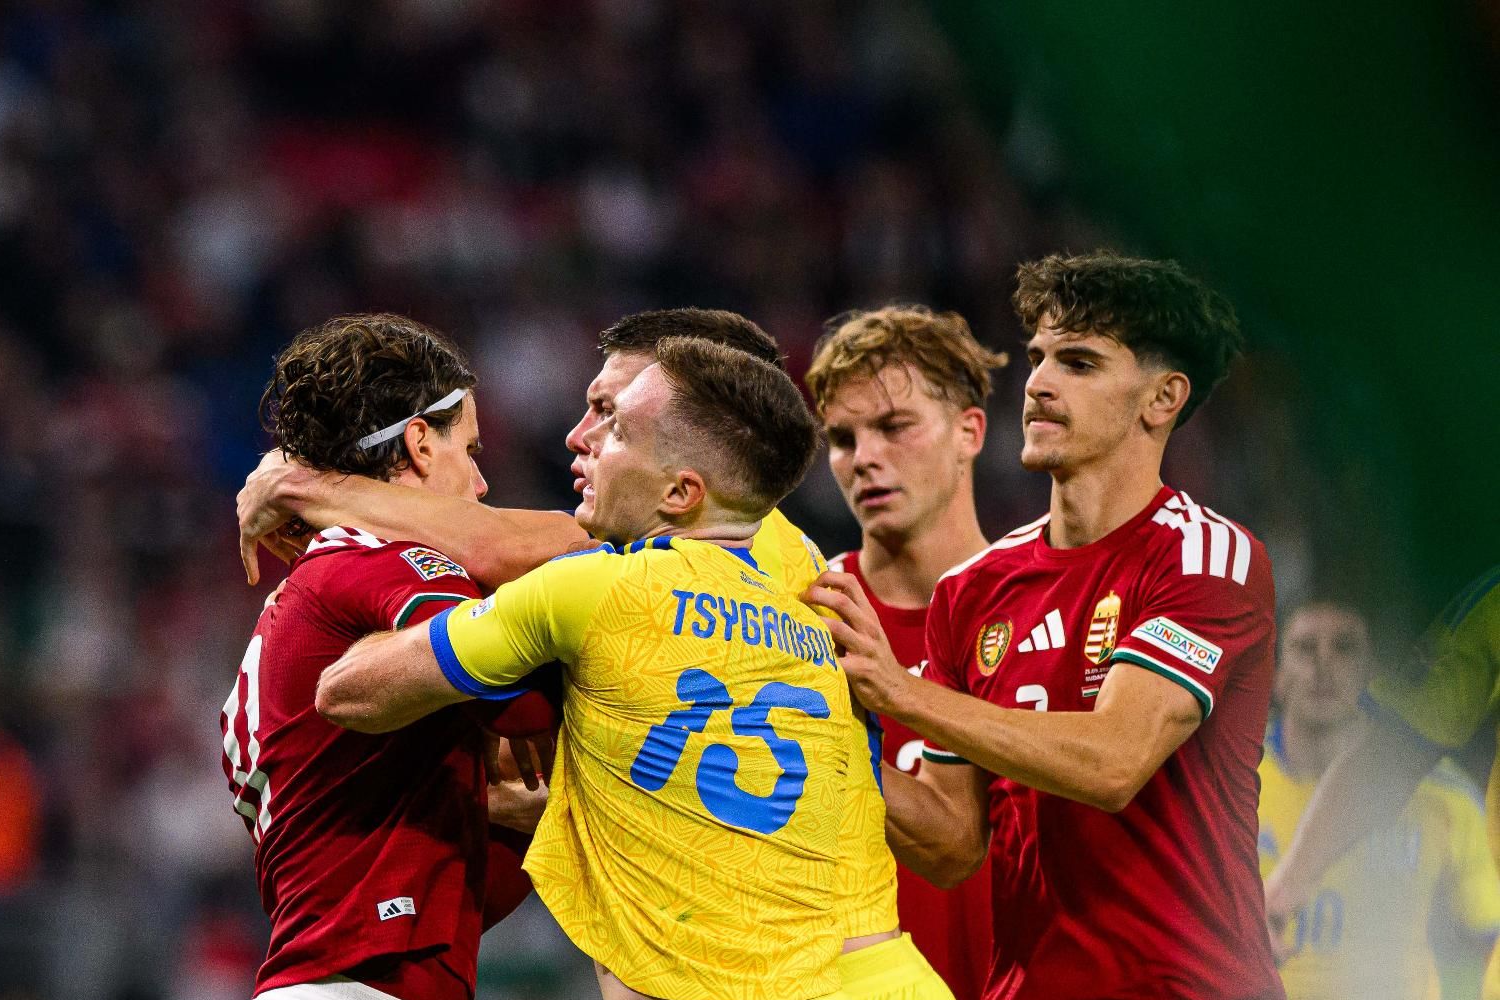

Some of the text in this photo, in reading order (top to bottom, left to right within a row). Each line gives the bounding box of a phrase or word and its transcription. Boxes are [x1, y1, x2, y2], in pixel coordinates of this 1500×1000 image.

[672, 588, 838, 672] TSYGANKOV
[1145, 622, 1217, 665] OUNDATION
[629, 668, 831, 835] 15
